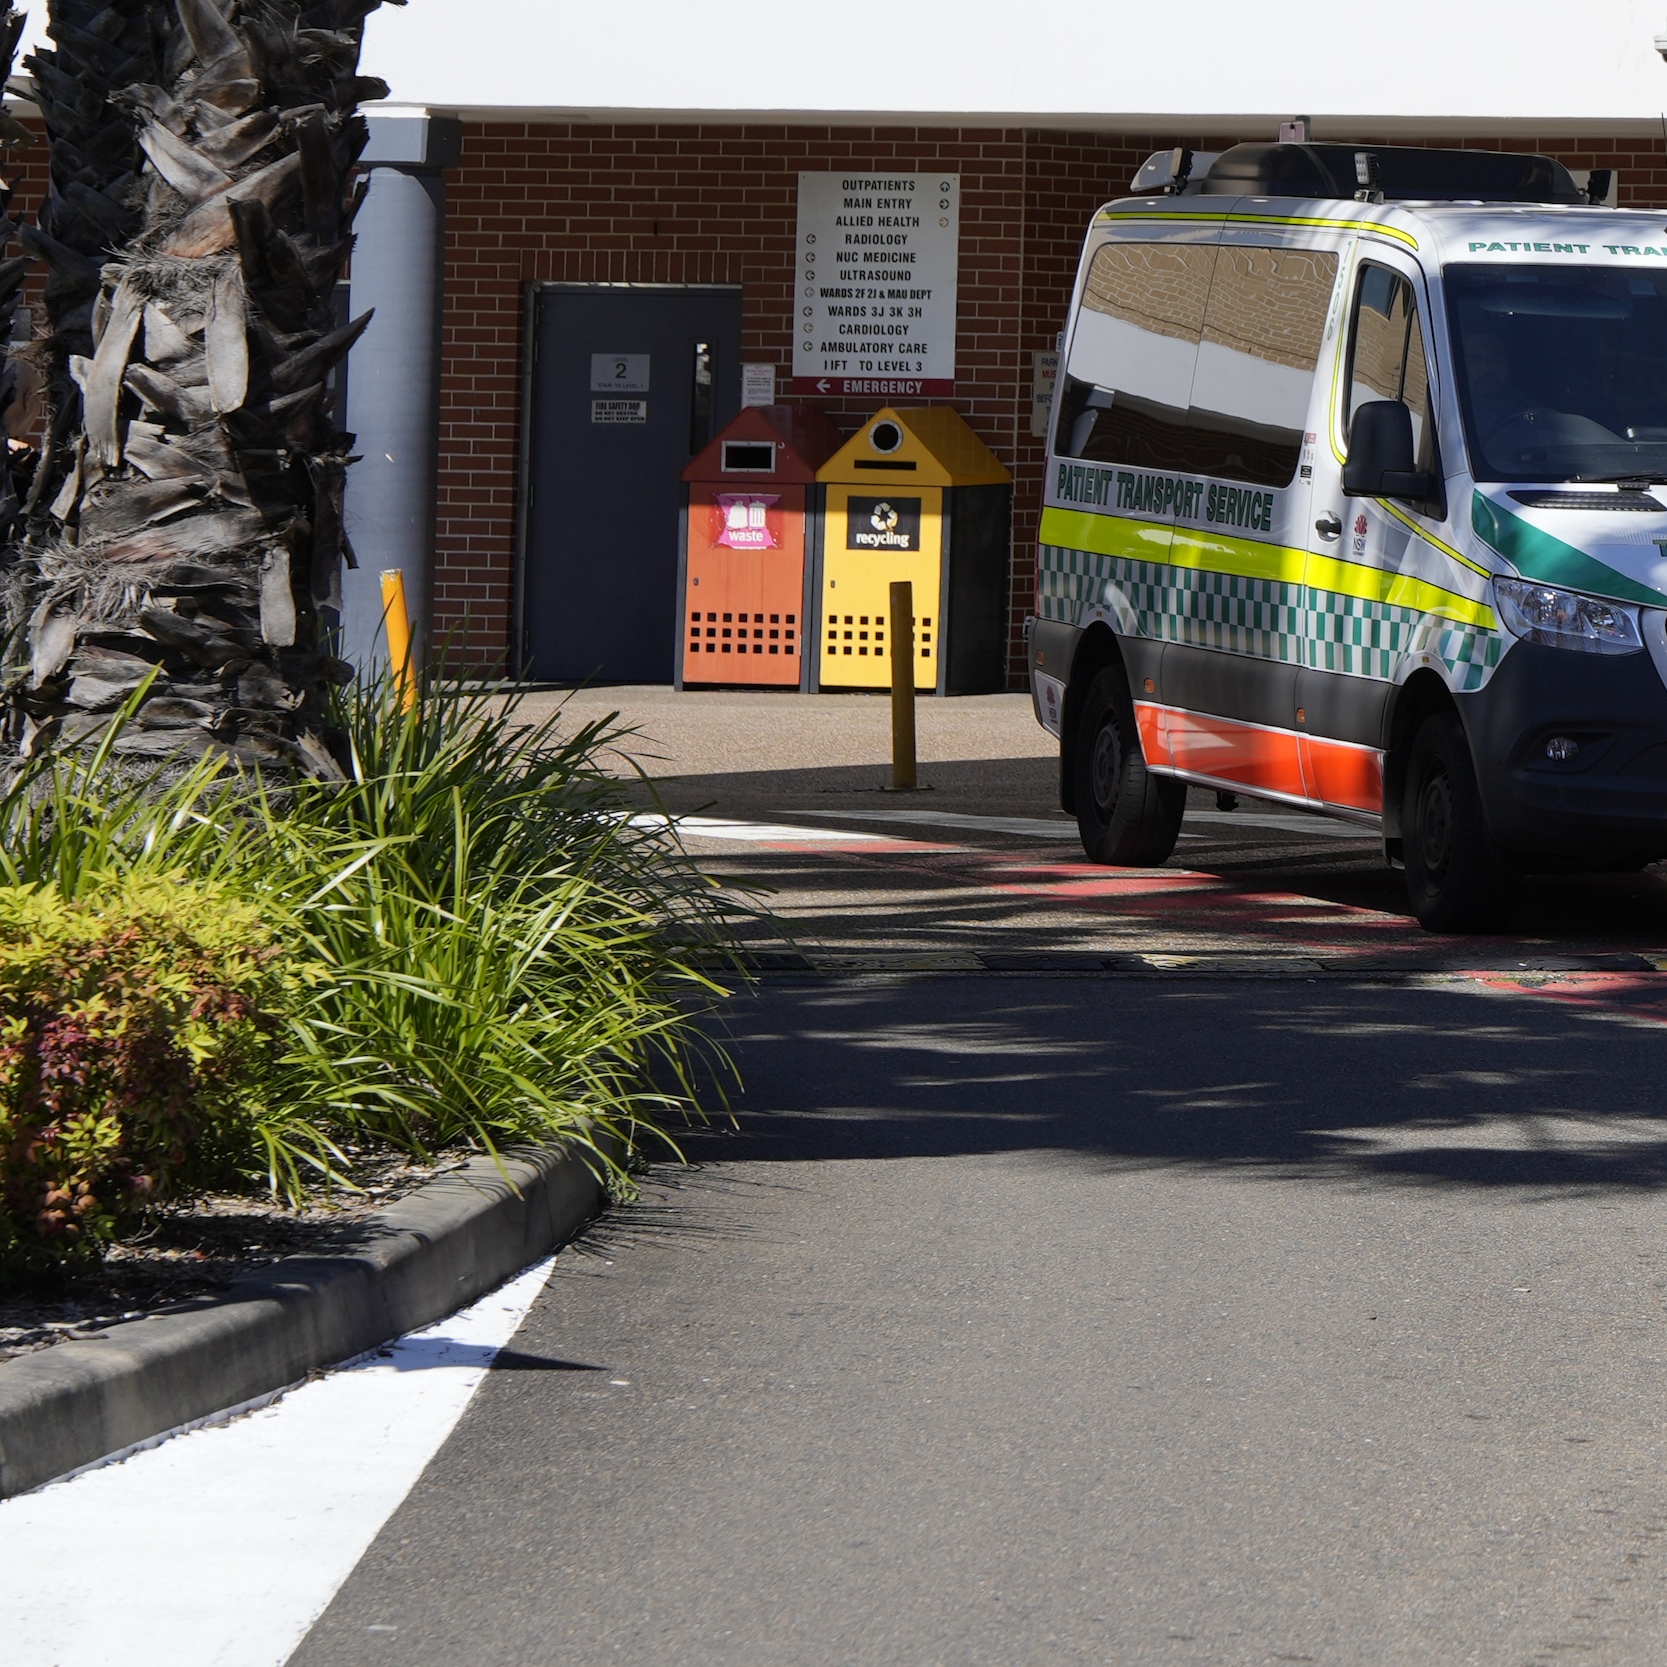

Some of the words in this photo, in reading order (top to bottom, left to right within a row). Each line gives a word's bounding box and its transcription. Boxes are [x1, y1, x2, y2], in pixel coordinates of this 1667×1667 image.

[842, 179, 915, 191] OUTPATIENTS
[843, 198, 872, 209] MAIN
[877, 198, 912, 209] ENTRY
[835, 216, 873, 227] ALLIED
[878, 216, 920, 227] HEALTH
[845, 234, 908, 245] RADIOLOGY
[1468, 241, 1591, 254] PATIENT
[836, 252, 859, 263] NUC
[863, 252, 916, 263] MEDICINE
[840, 270, 911, 281] ULTRASOUND
[820, 288, 853, 299] WARDS
[855, 288, 866, 299] 2F
[867, 288, 877, 299] 2J
[879, 290, 885, 299] &
[887, 289, 908, 300] MAU
[910, 289, 932, 300] DEPT
[828, 306, 866, 317] WARDS
[871, 306, 884, 318] 3J
[889, 306, 903, 318] 3K
[908, 307, 922, 318] 3H
[839, 324, 909, 335] CARDIOLOGY
[820, 342, 894, 354] AMBULATORY
[898, 343, 928, 354] CARE
[615, 363, 627, 379] 2
[859, 361, 873, 372] TO
[877, 361, 911, 372] LEVEL
[916, 361, 922, 372] 3
[1042, 369, 1057, 379] MUS
[843, 380, 923, 394] EMERGENCY
[1057, 464, 1112, 505] PATIENT
[1116, 471, 1203, 519] TRANSPORT
[1206, 485, 1274, 531] SERVICE
[728, 530, 764, 543] waste
[855, 532, 910, 548] recycling
[1352, 537, 1367, 552] NSW
